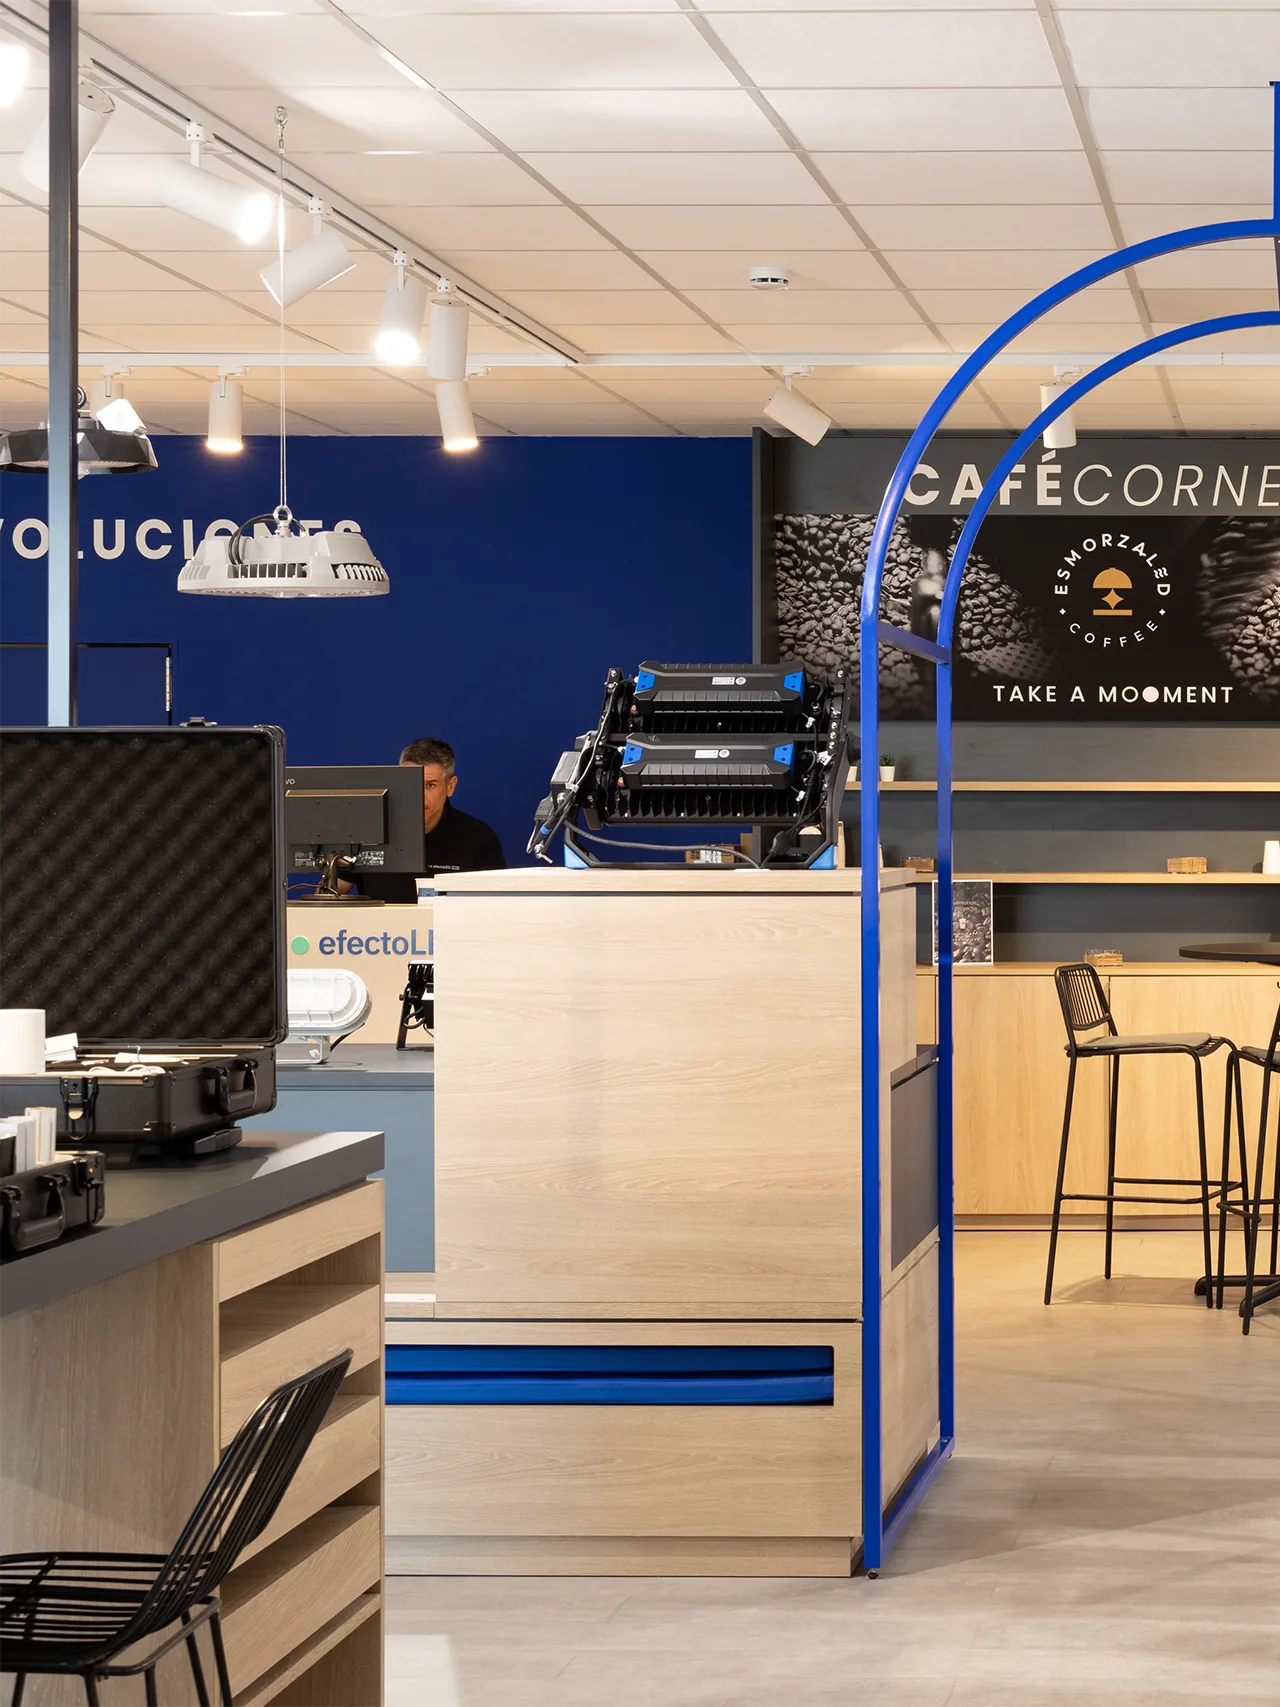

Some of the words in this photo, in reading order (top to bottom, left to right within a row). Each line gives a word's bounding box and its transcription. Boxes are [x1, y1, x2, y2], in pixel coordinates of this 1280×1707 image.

[1069, 620, 1158, 648] COFFEE
[993, 685, 1057, 703] TAKE
[1070, 686, 1085, 703] A
[319, 929, 434, 956] efectoL
